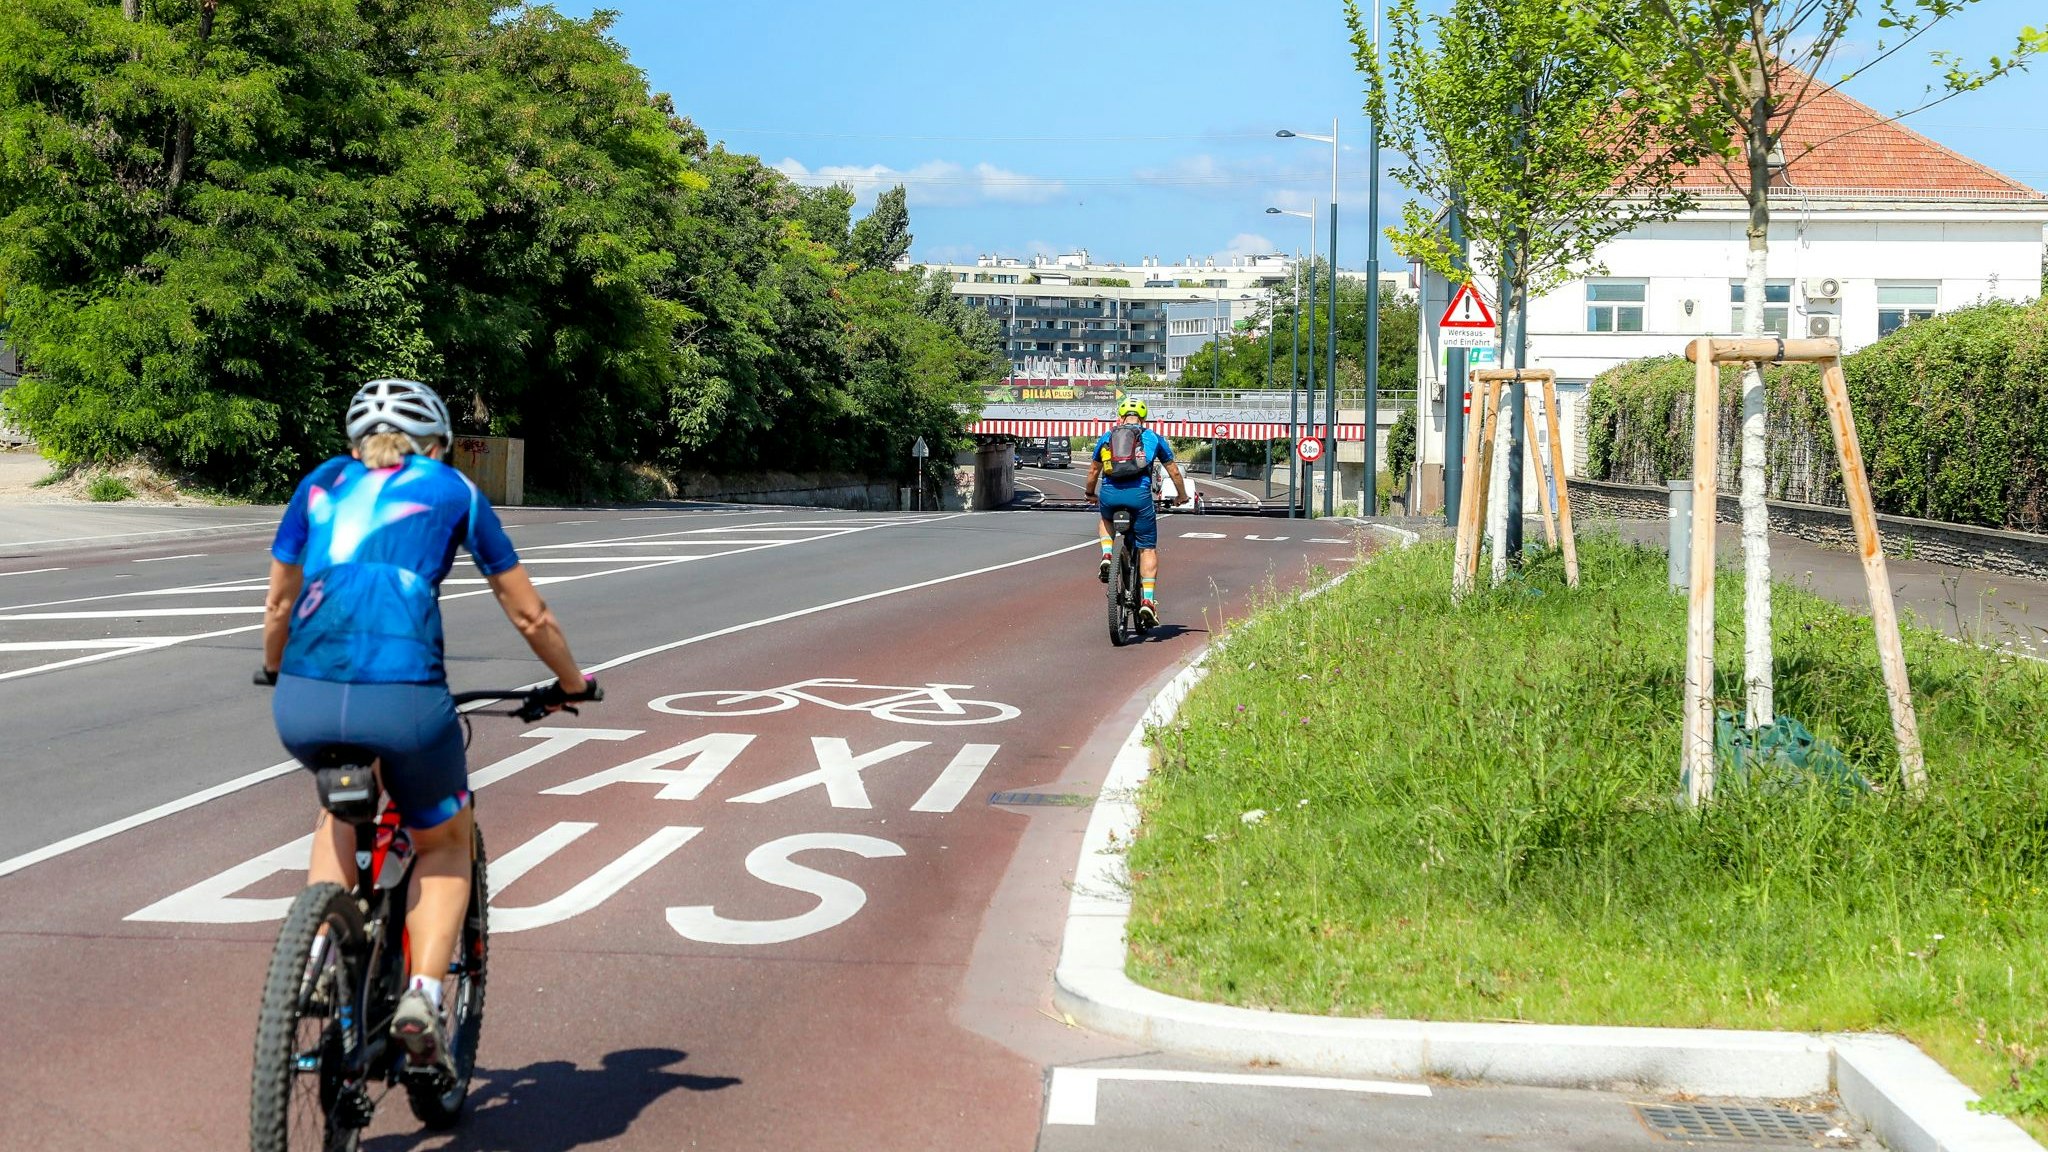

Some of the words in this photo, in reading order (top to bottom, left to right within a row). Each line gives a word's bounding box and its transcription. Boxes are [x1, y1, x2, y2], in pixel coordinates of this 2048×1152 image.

[1448, 329, 1486, 337] Werksaus-
[1444, 338, 1457, 346] und
[1460, 338, 1490, 346] Einfahrt
[1022, 388, 1052, 400] BILLA
[468, 727, 999, 813] TAXI
